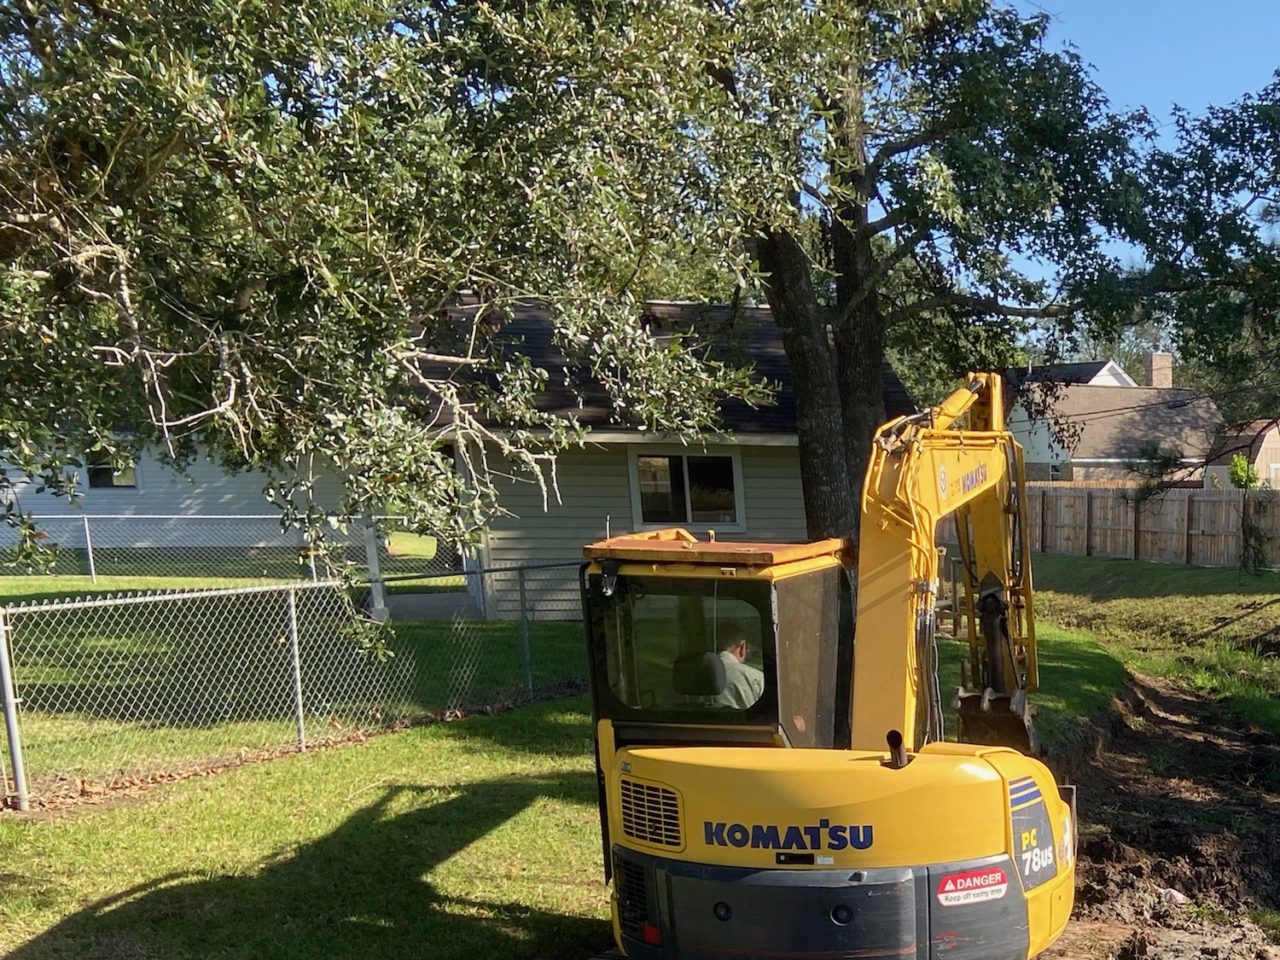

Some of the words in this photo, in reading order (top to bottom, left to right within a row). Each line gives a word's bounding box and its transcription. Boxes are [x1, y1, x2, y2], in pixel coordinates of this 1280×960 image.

[704, 819, 873, 850] KOMATSU
[1022, 828, 1037, 851] PC
[957, 873, 1002, 889] DANGER
